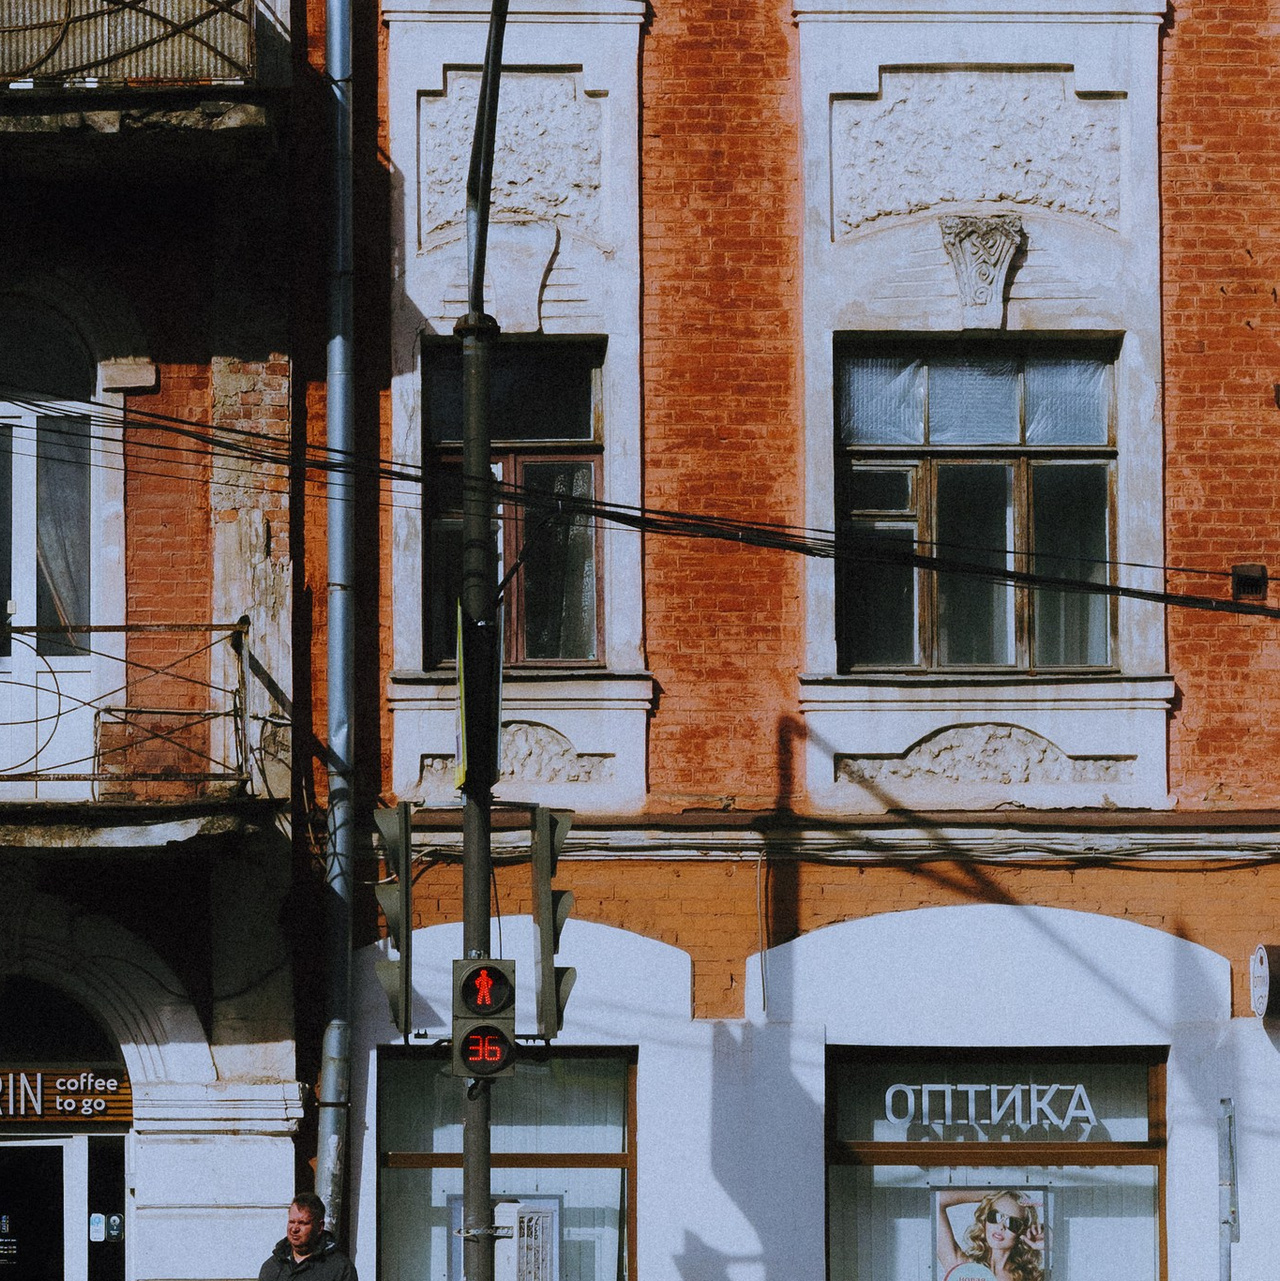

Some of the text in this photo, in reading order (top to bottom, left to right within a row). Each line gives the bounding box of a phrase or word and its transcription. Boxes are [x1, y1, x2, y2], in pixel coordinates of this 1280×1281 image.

[469, 1035, 501, 1061] 36
[55, 1073, 118, 1091] coffee
[55, 1095, 106, 1114] to go
[885, 1083, 1098, 1125] ОПТИКА
